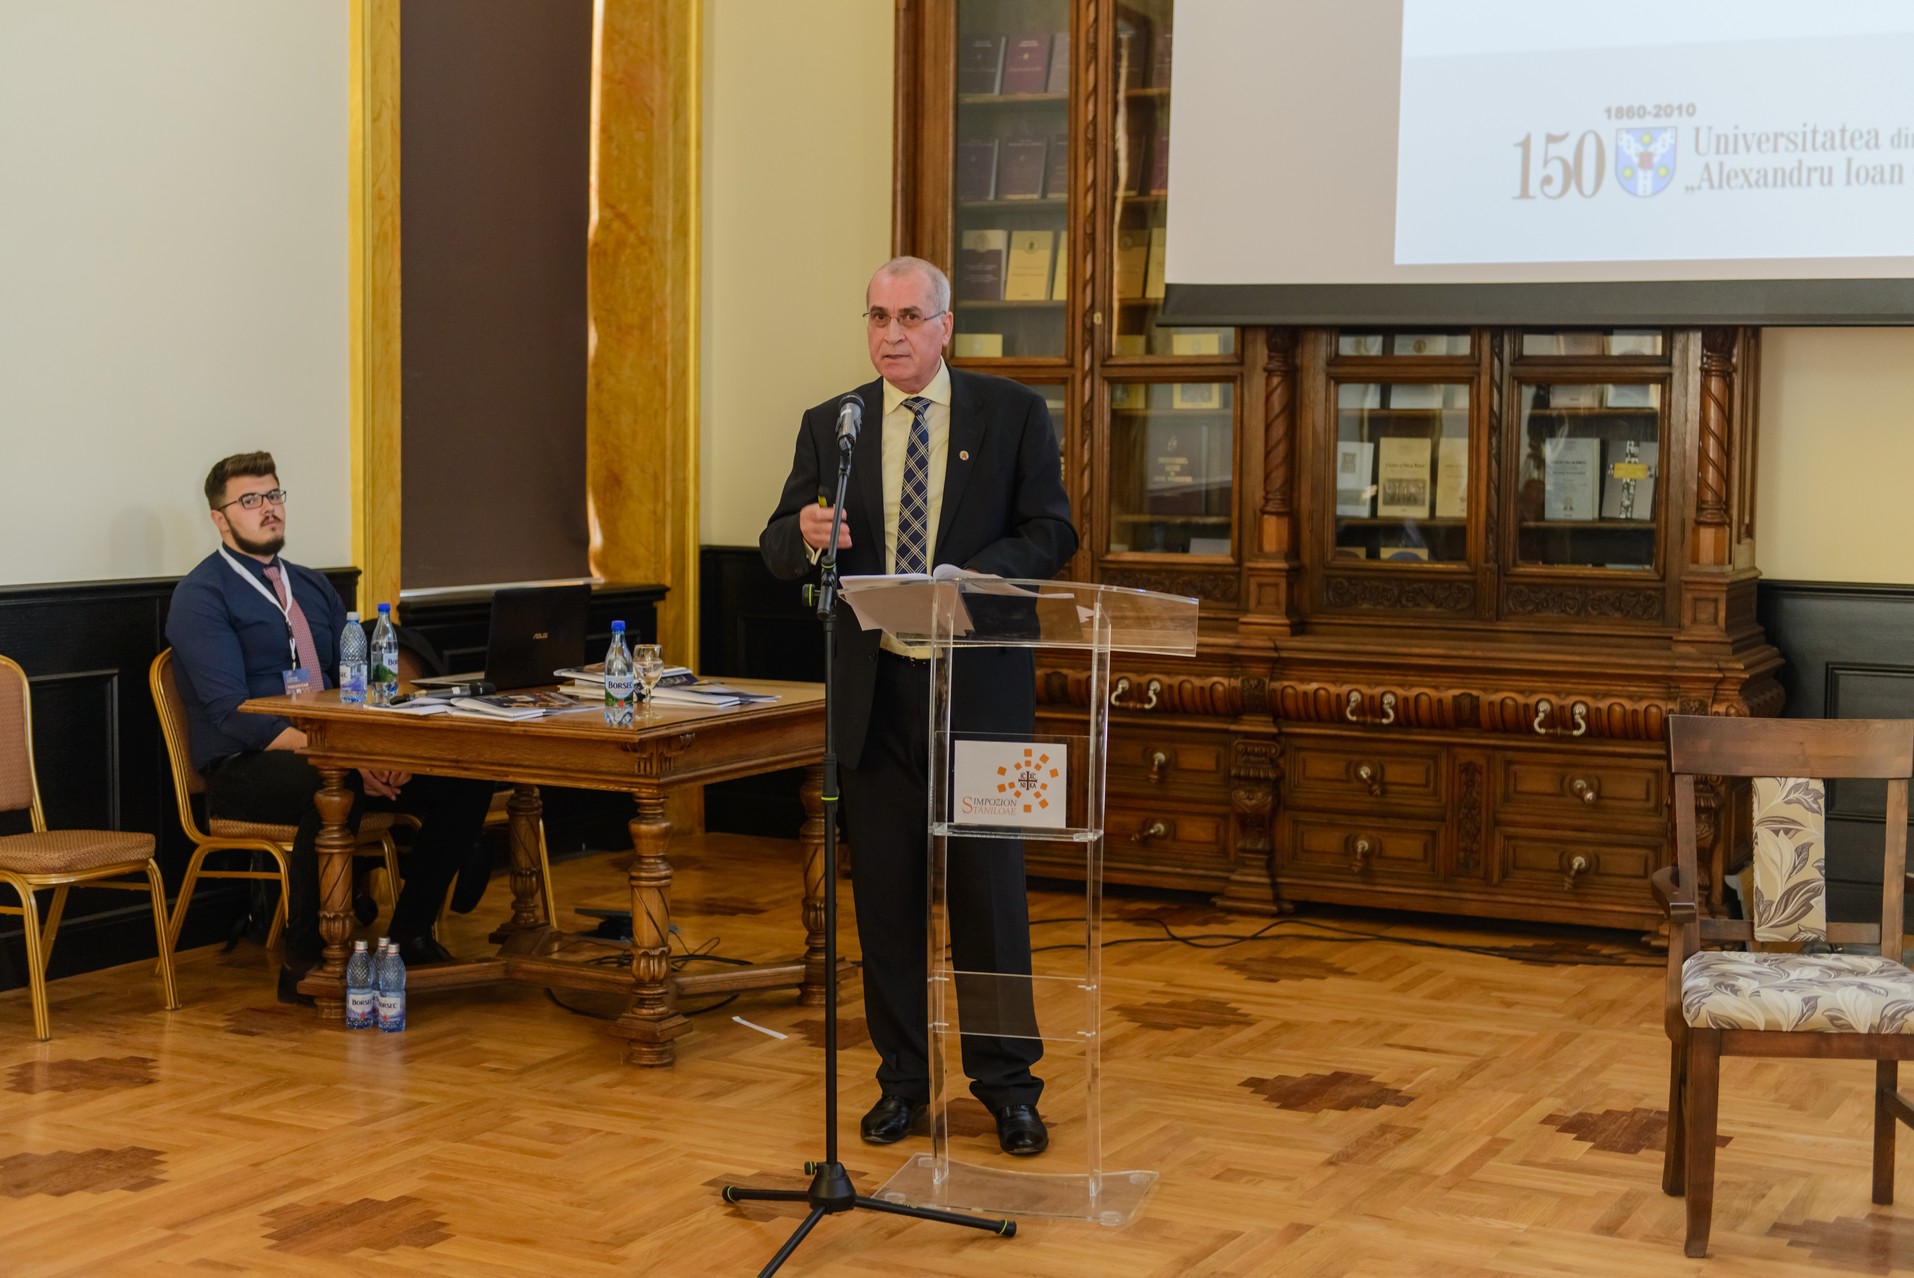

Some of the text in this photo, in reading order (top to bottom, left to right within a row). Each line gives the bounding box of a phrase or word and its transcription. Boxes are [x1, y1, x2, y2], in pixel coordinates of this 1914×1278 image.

[1604, 103, 1697, 121] 1860-2010
[1693, 122, 1880, 157] Universitatea
[1511, 129, 1606, 200] 150
[1842, 156, 1904, 187] Ioan
[608, 681, 633, 689] BORSEC
